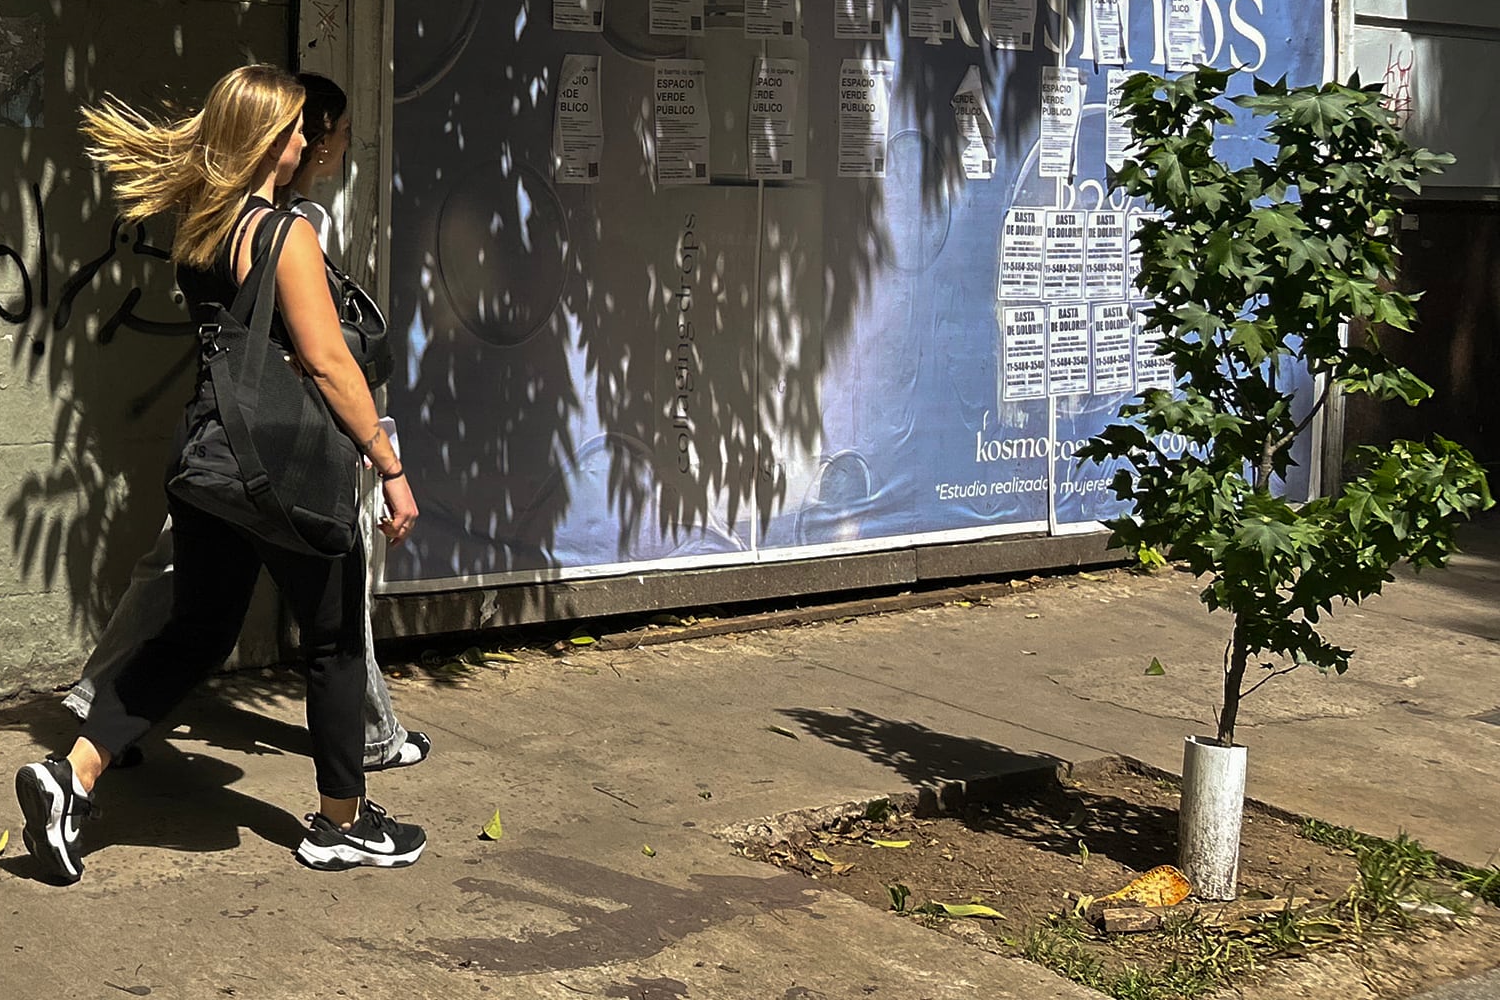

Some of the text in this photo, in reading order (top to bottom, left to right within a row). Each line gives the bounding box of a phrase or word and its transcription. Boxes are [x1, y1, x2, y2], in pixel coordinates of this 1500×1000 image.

[657, 79, 695, 89] ESPACIO
[842, 77, 875, 88] ESPACIO
[1042, 84, 1072, 94] ESPACIO
[656, 92, 685, 101] VERDE
[754, 90, 775, 100] ERDE
[841, 90, 868, 100] VERDE
[1042, 96, 1064, 105] VERDE
[560, 103, 589, 112] BLICO
[1014, 212, 1036, 223] BASTA
[1055, 214, 1076, 225] BASTA
[1096, 214, 1115, 225] BASTA
[1006, 225, 1014, 235] DE
[1014, 311, 1036, 322] BASTA
[1058, 307, 1079, 319] BASTA
[1103, 306, 1123, 318] BASTA
[1007, 325, 1015, 336] DE
[1050, 321, 1058, 332] DE
